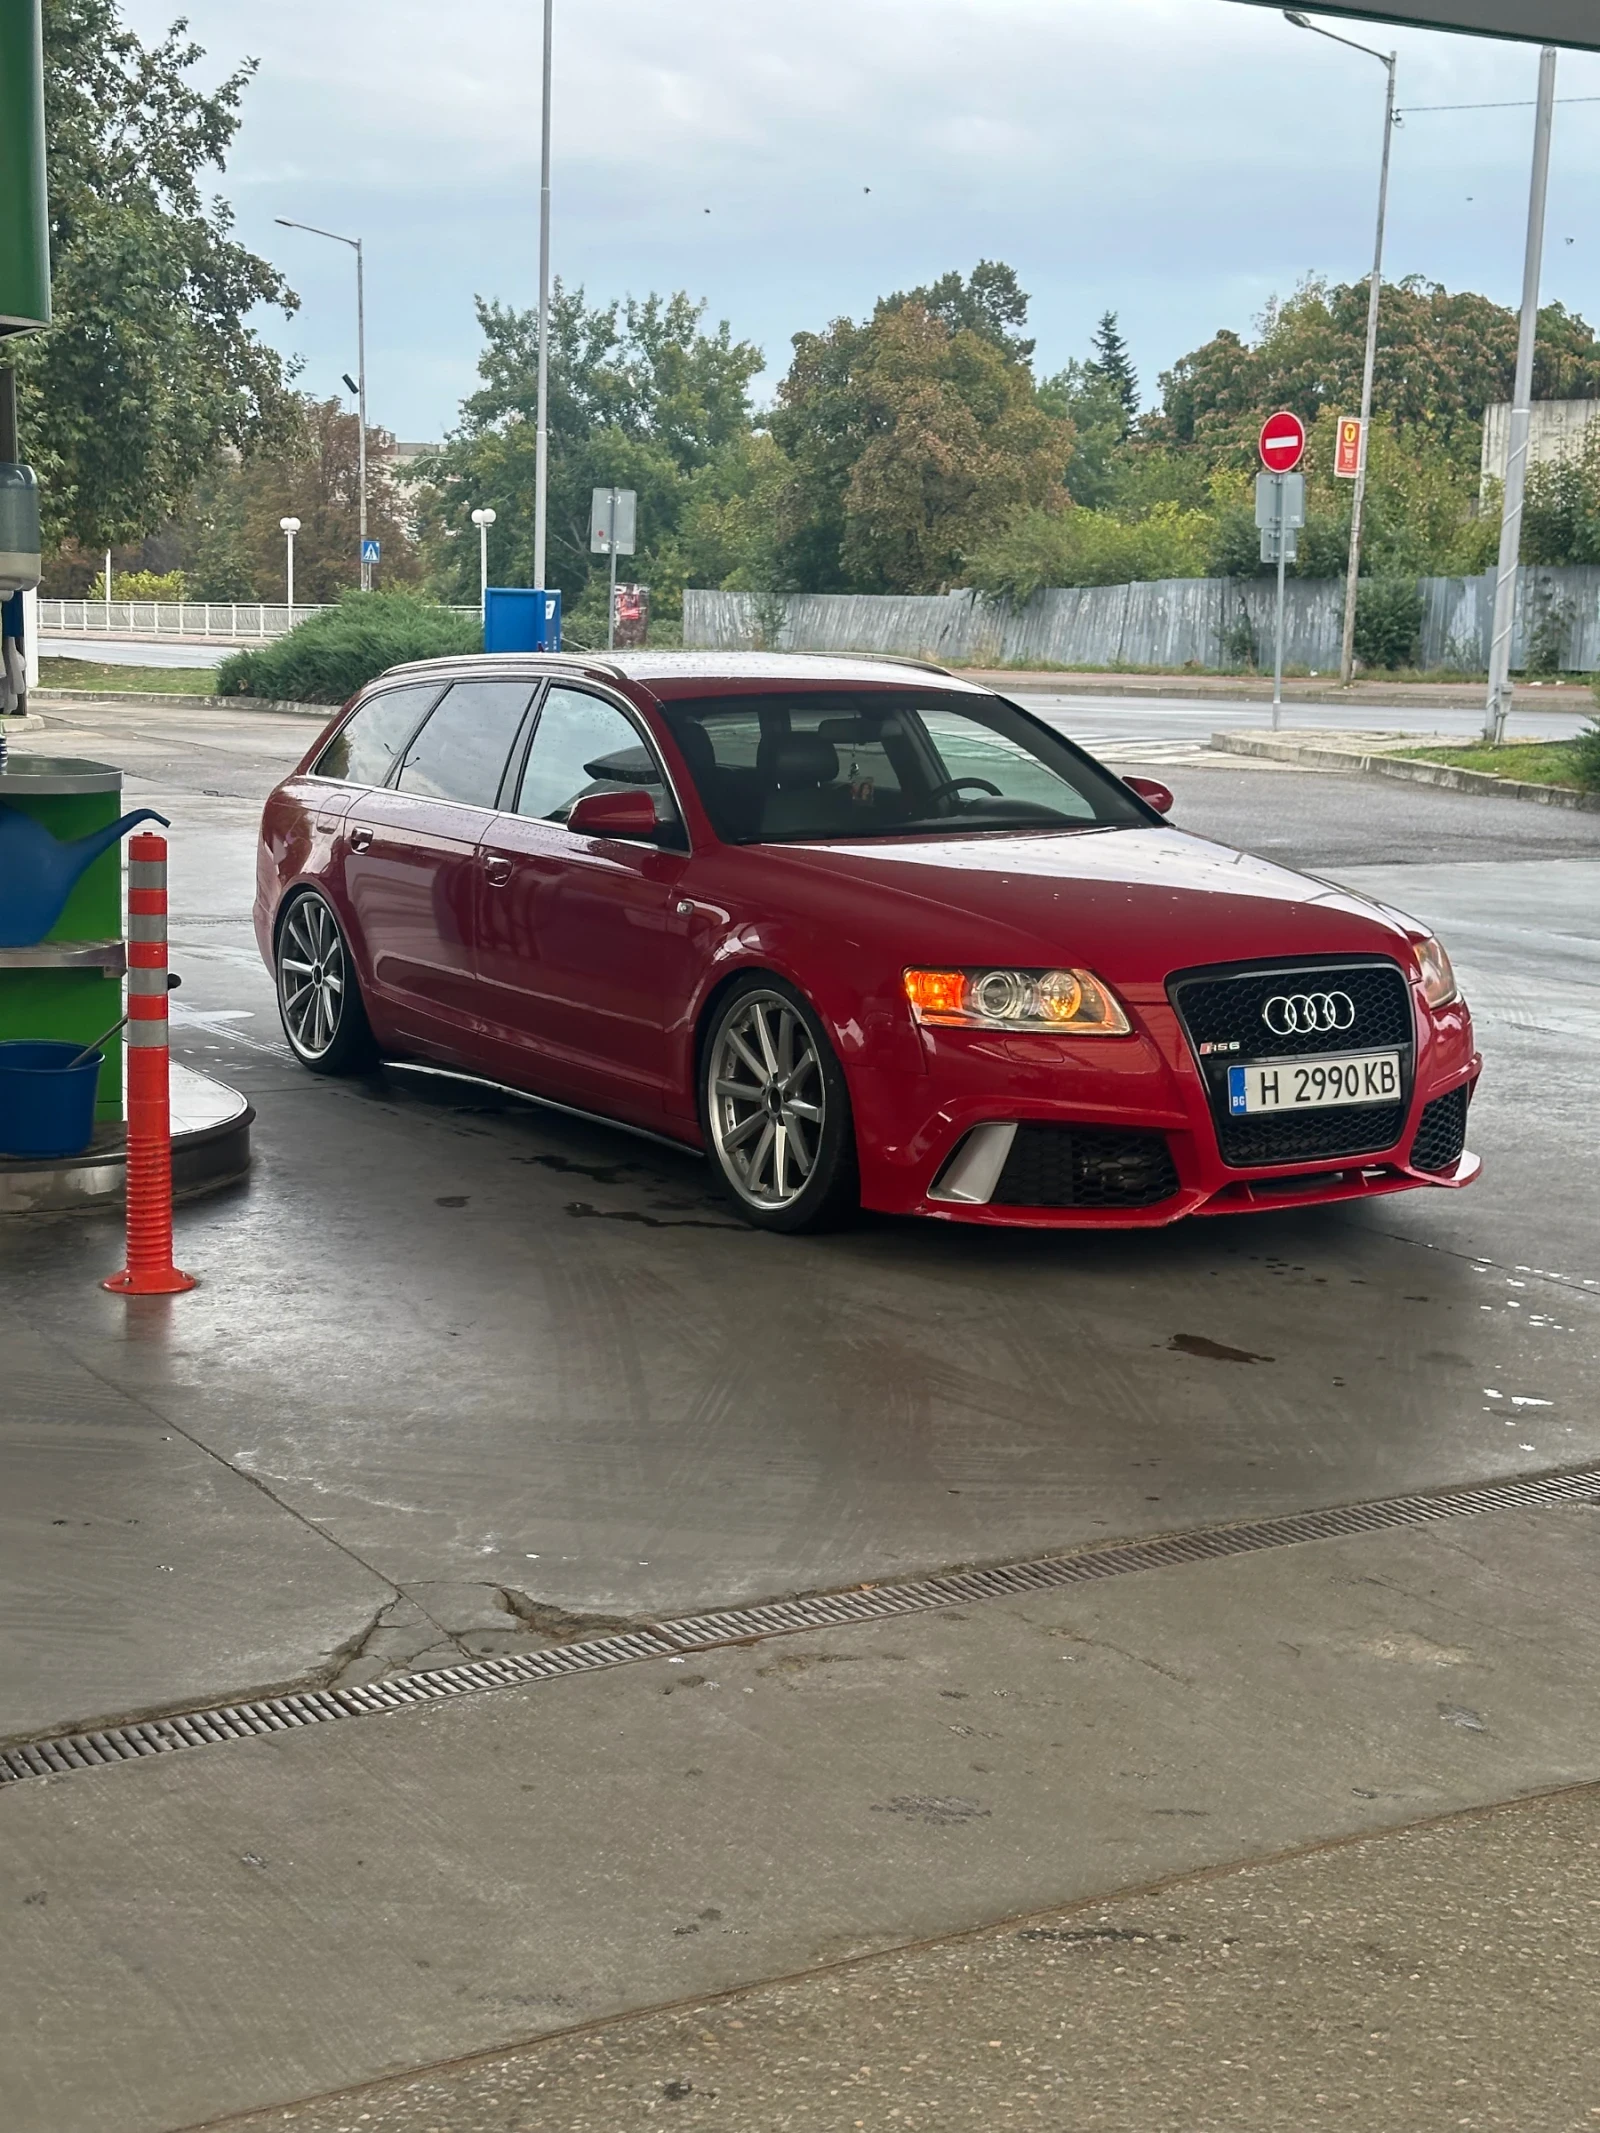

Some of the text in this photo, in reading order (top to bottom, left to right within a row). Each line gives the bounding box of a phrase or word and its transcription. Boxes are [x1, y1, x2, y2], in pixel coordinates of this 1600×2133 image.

[1202, 1041, 1241, 1054] RS6
[1260, 1061, 1396, 1105] H 2990 KB
[1232, 1095, 1245, 1107] BG
